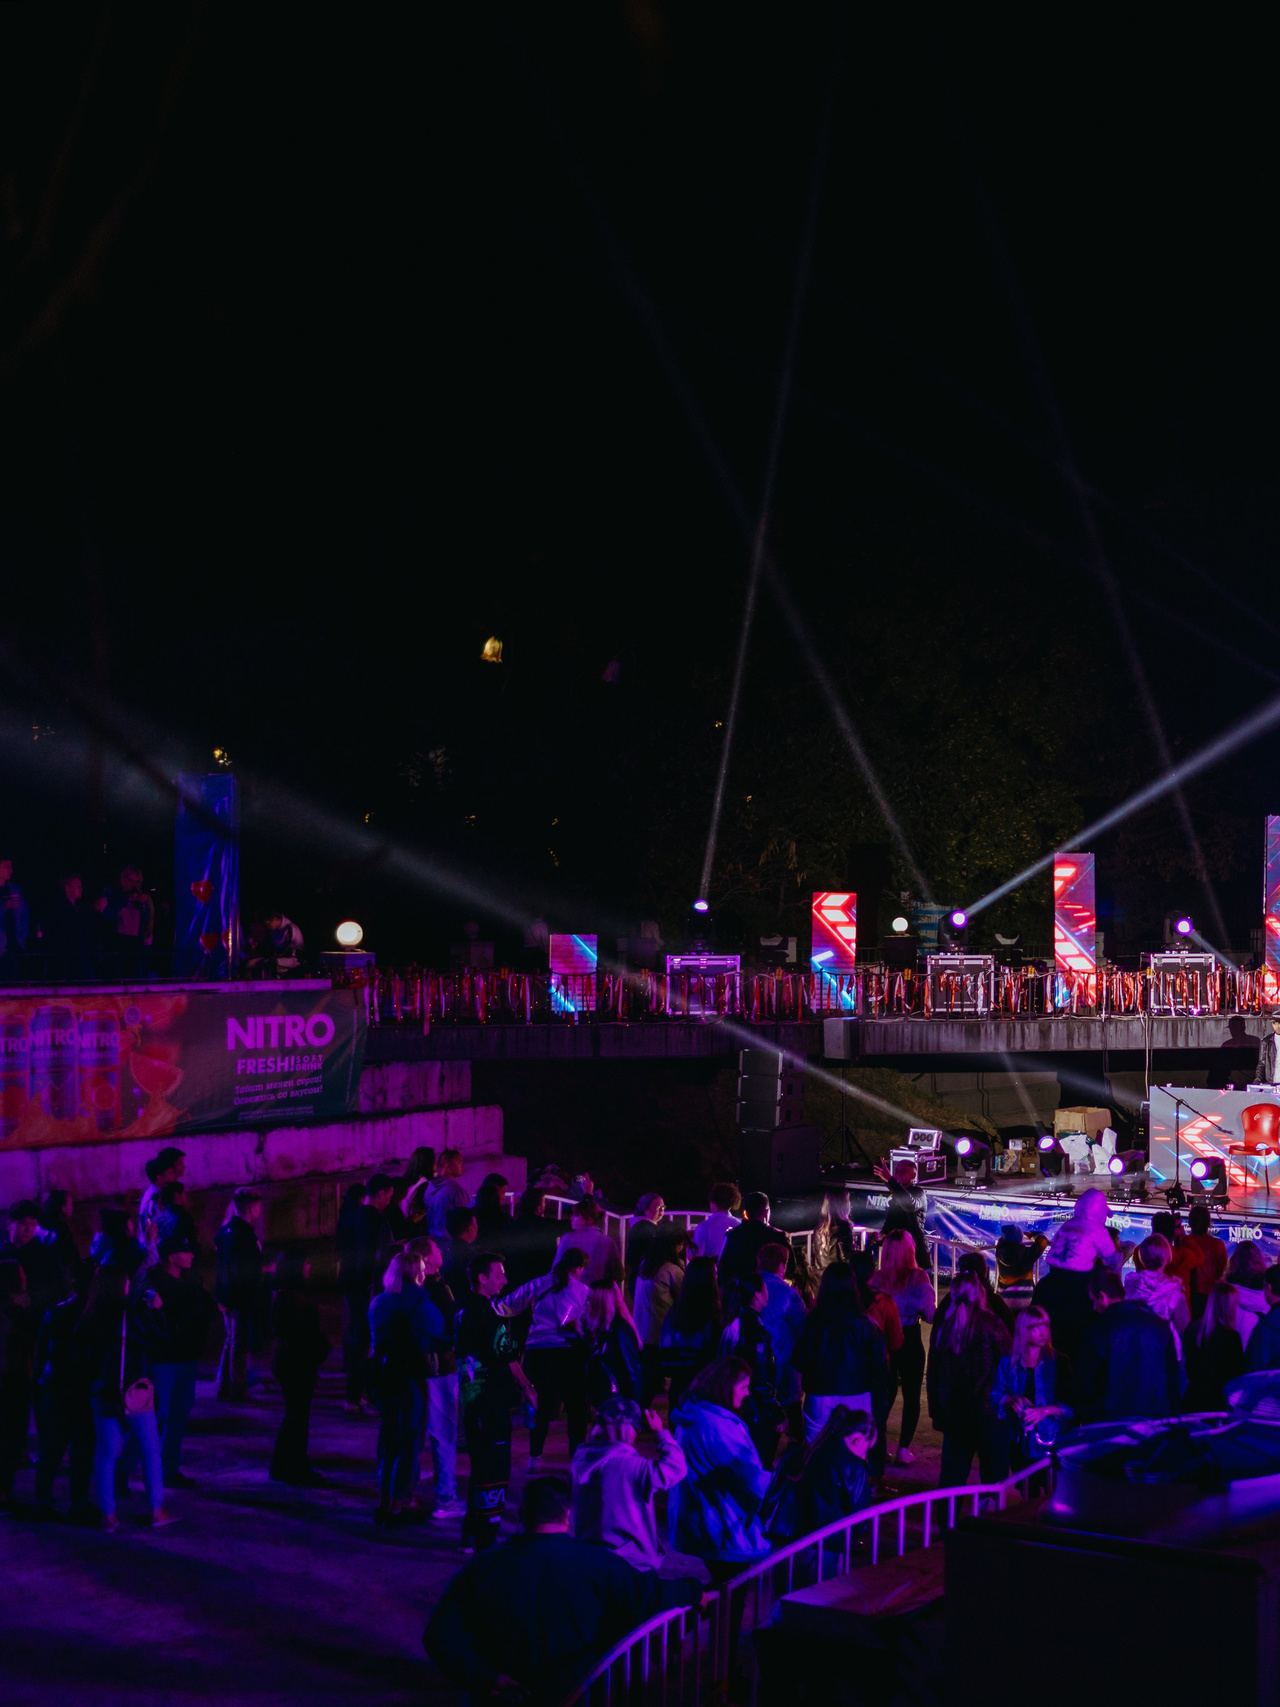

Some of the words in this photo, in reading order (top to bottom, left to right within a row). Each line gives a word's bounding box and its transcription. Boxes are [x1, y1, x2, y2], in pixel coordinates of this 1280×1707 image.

[226, 1013, 335, 1050] NITRO
[236, 1056, 295, 1075] FRESH!
[296, 1054, 323, 1063] SOFT
[295, 1062, 323, 1071] DRINK
[277, 1091, 289, 1099] со
[290, 1084, 323, 1097] вкусом!
[1228, 1226, 1263, 1240] NITRO
